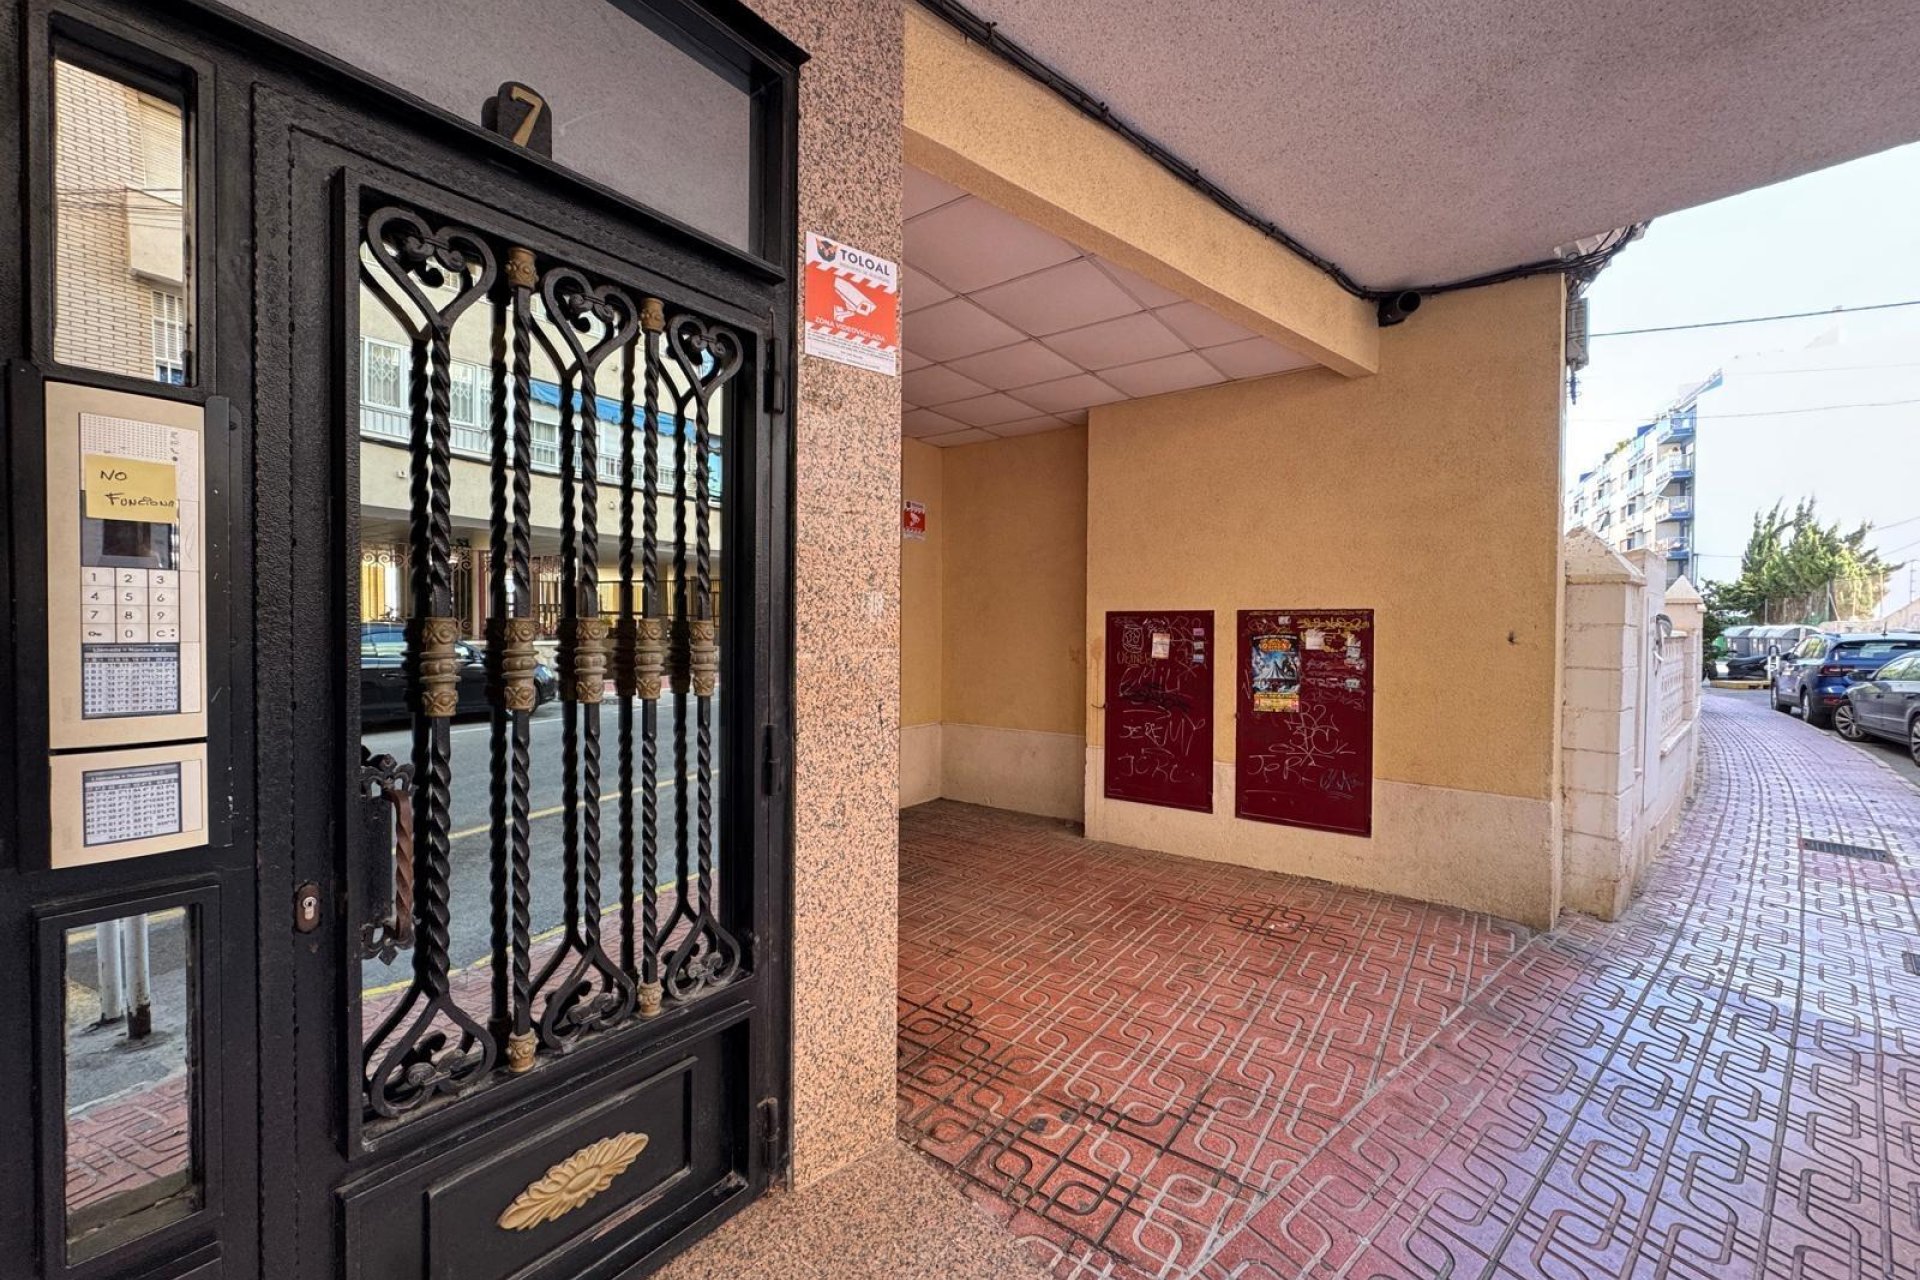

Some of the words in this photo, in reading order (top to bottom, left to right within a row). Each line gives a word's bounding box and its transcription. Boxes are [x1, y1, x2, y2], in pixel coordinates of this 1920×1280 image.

[510, 86, 544, 148] 7
[840, 249, 890, 276] TOLOAL
[100, 469, 127, 481] NO
[91, 572, 97, 582] 1
[124, 574, 133, 584] 2
[156, 575, 165, 585] 3
[90, 592, 99, 601] 4
[124, 592, 133, 602] 5
[157, 594, 165, 603] 6
[90, 610, 99, 620] 7
[124, 611, 133, 620] 8
[156, 611, 165, 620] 9
